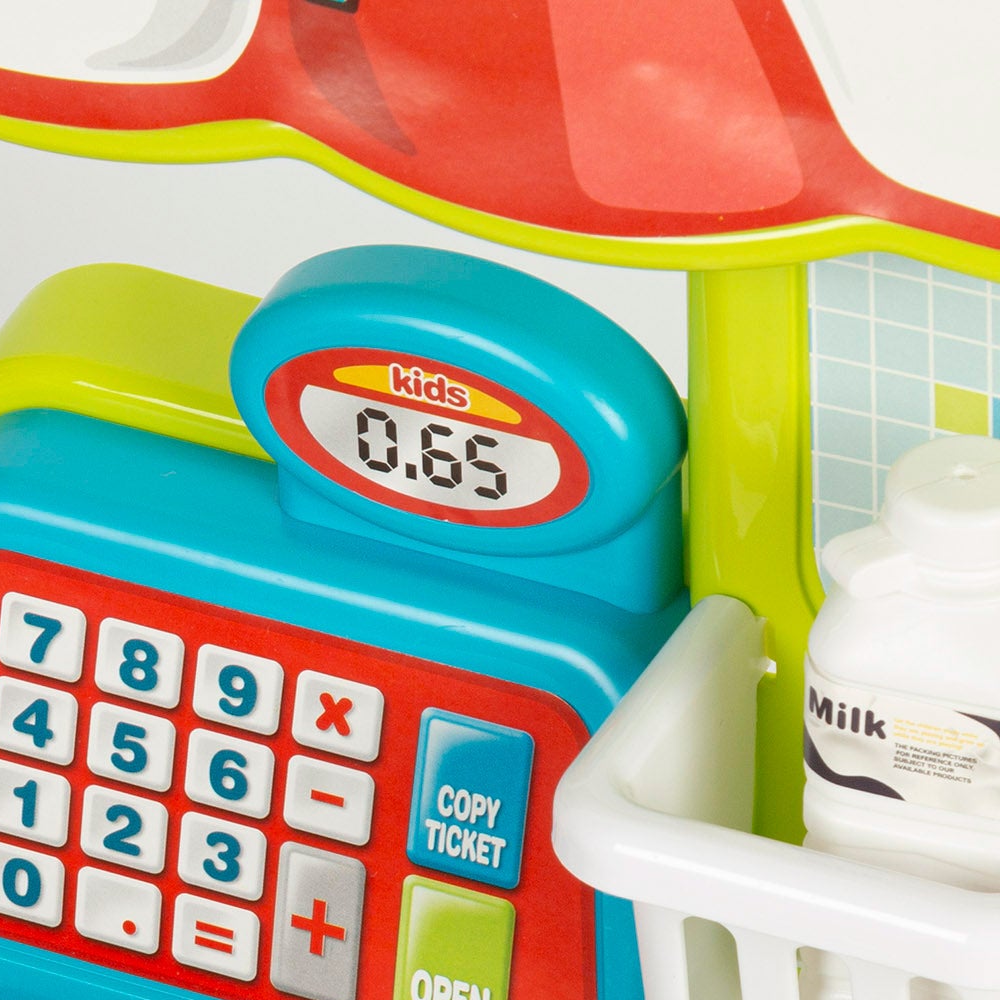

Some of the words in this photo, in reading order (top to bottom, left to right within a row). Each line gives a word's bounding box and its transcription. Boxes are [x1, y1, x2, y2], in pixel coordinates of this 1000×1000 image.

[389, 363, 470, 411] kids
[356, 407, 507, 500] 0.65
[23, 612, 62, 664] 7
[119, 638, 158, 692] 8
[218, 664, 258, 717] 9
[12, 698, 54, 748] 4
[809, 685, 886, 740] Milk
[111, 721, 149, 773] 5
[893, 756, 925, 767] SUBJECT
[938, 765, 955, 773] OUR
[895, 742, 908, 750] THE
[909, 746, 941, 757] PACKING
[942, 752, 978, 764] PICTURES
[911, 753, 952, 766] REFERENCE
[208, 748, 249, 801] 6
[893, 763, 931, 776] AVAILABLE
[932, 772, 972, 784] PRODUCTS
[13, 779, 39, 829] 1
[437, 783, 501, 830] COPY
[103, 804, 144, 857] 2
[425, 819, 506, 870] TICKET
[3, 857, 42, 908] 0
[203, 831, 242, 883] 3
